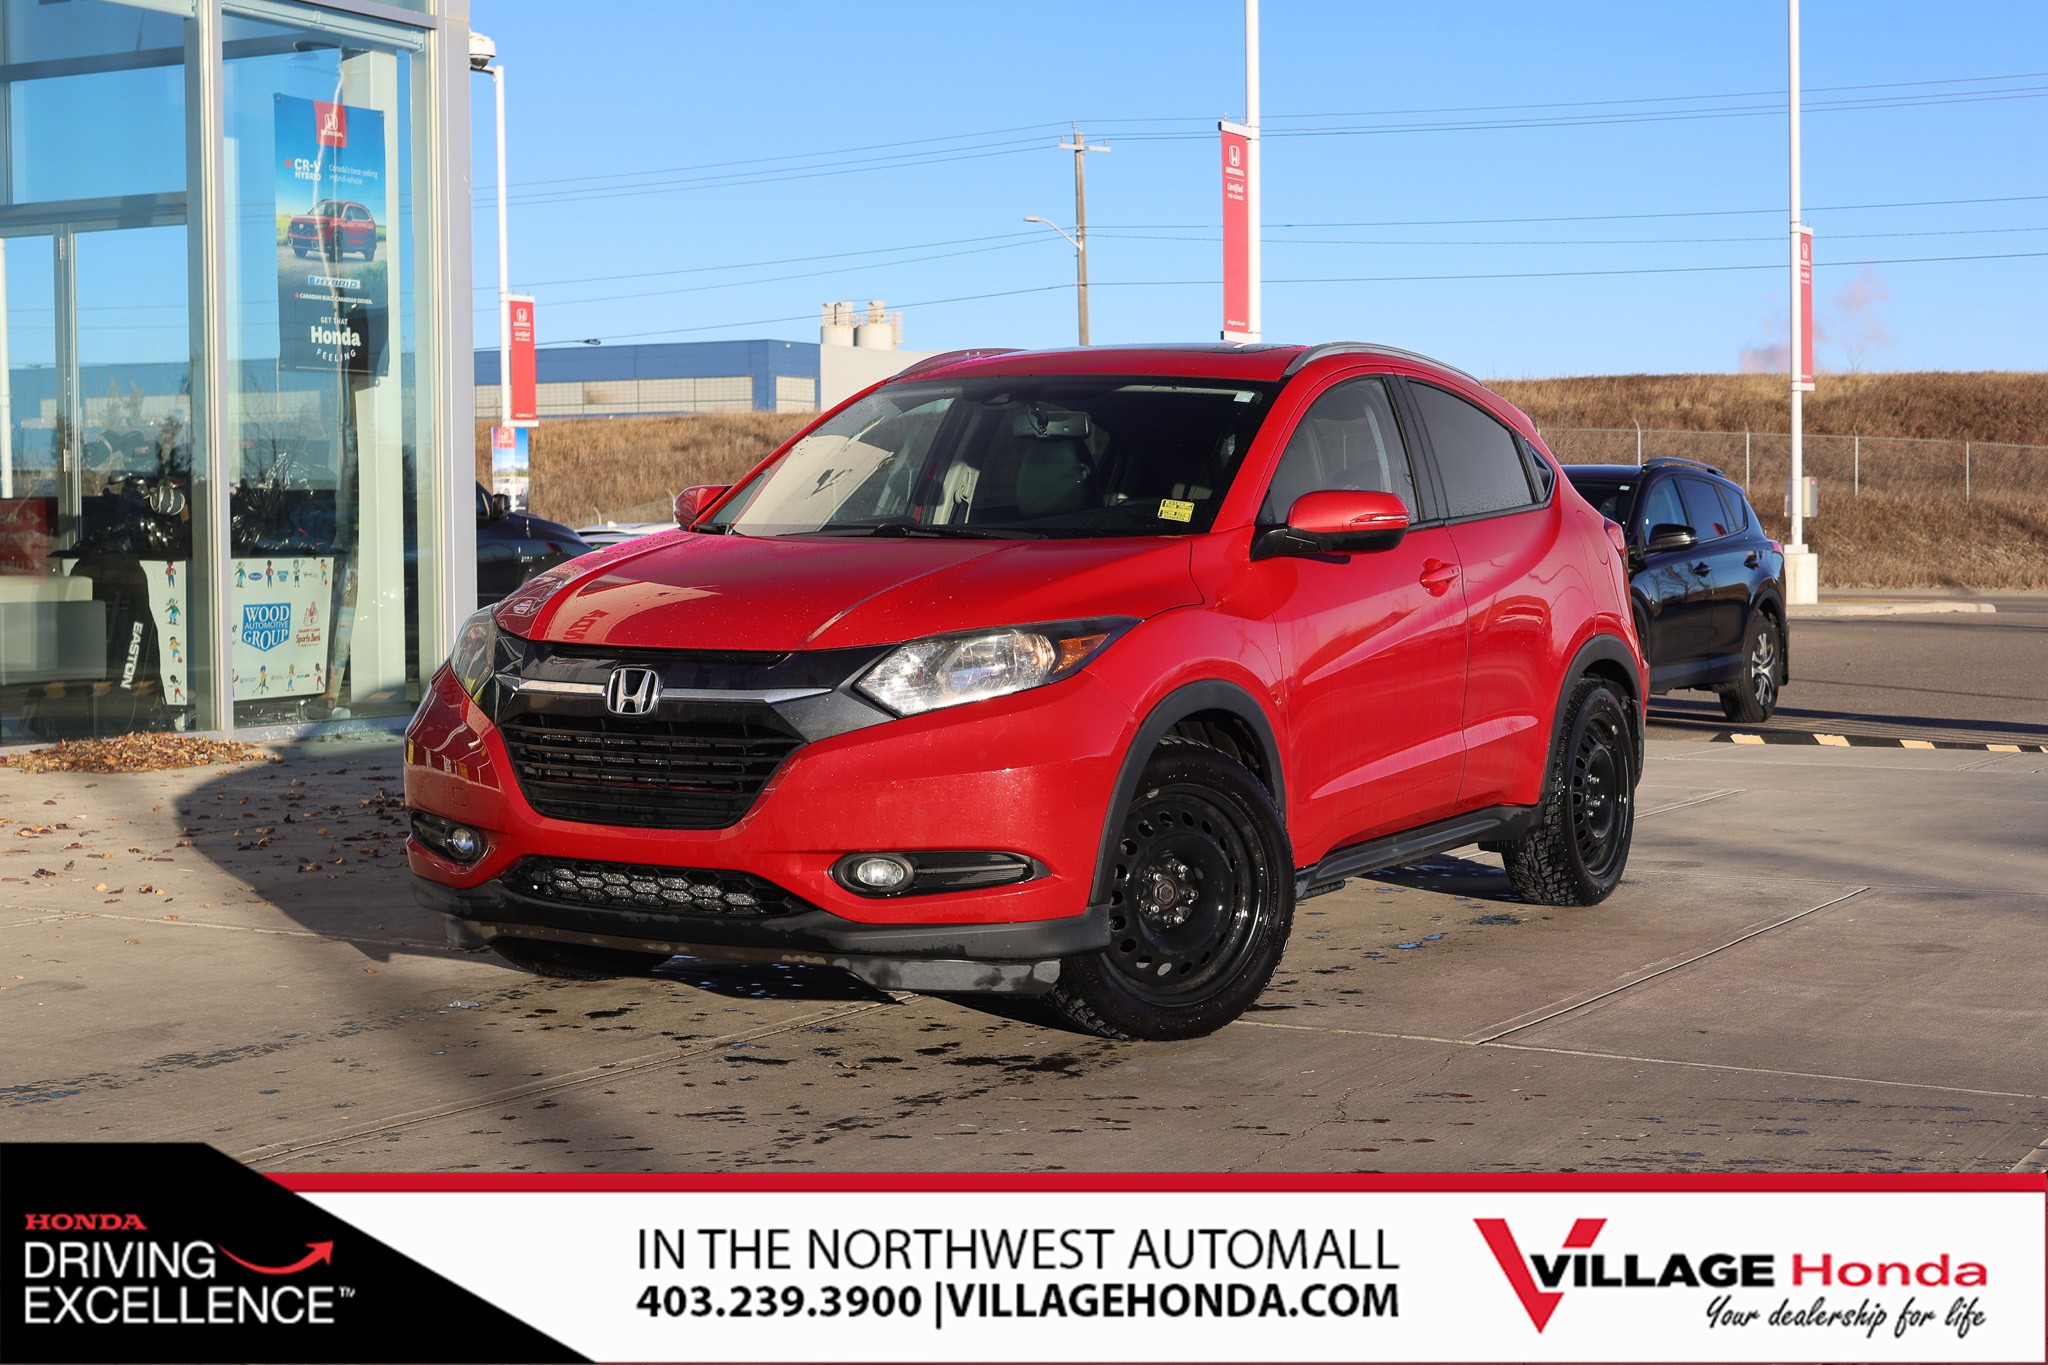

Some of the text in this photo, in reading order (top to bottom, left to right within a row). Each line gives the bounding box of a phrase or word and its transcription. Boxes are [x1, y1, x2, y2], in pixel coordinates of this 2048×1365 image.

[320, 129, 343, 138] HONDA
[294, 158, 321, 173] CR-V
[295, 171, 321, 181] HYBRID
[315, 277, 357, 288] HYBRID
[300, 293, 321, 301] CANADIAN
[333, 318, 348, 326] THAT
[310, 326, 361, 347] Honda
[316, 348, 356, 362] FEELING
[245, 605, 289, 623] WOOD
[244, 620, 289, 630] AUTOMOTIVE
[243, 629, 288, 650] GROUP
[295, 633, 310, 647] Sports
[120, 621, 144, 690] EASTON
